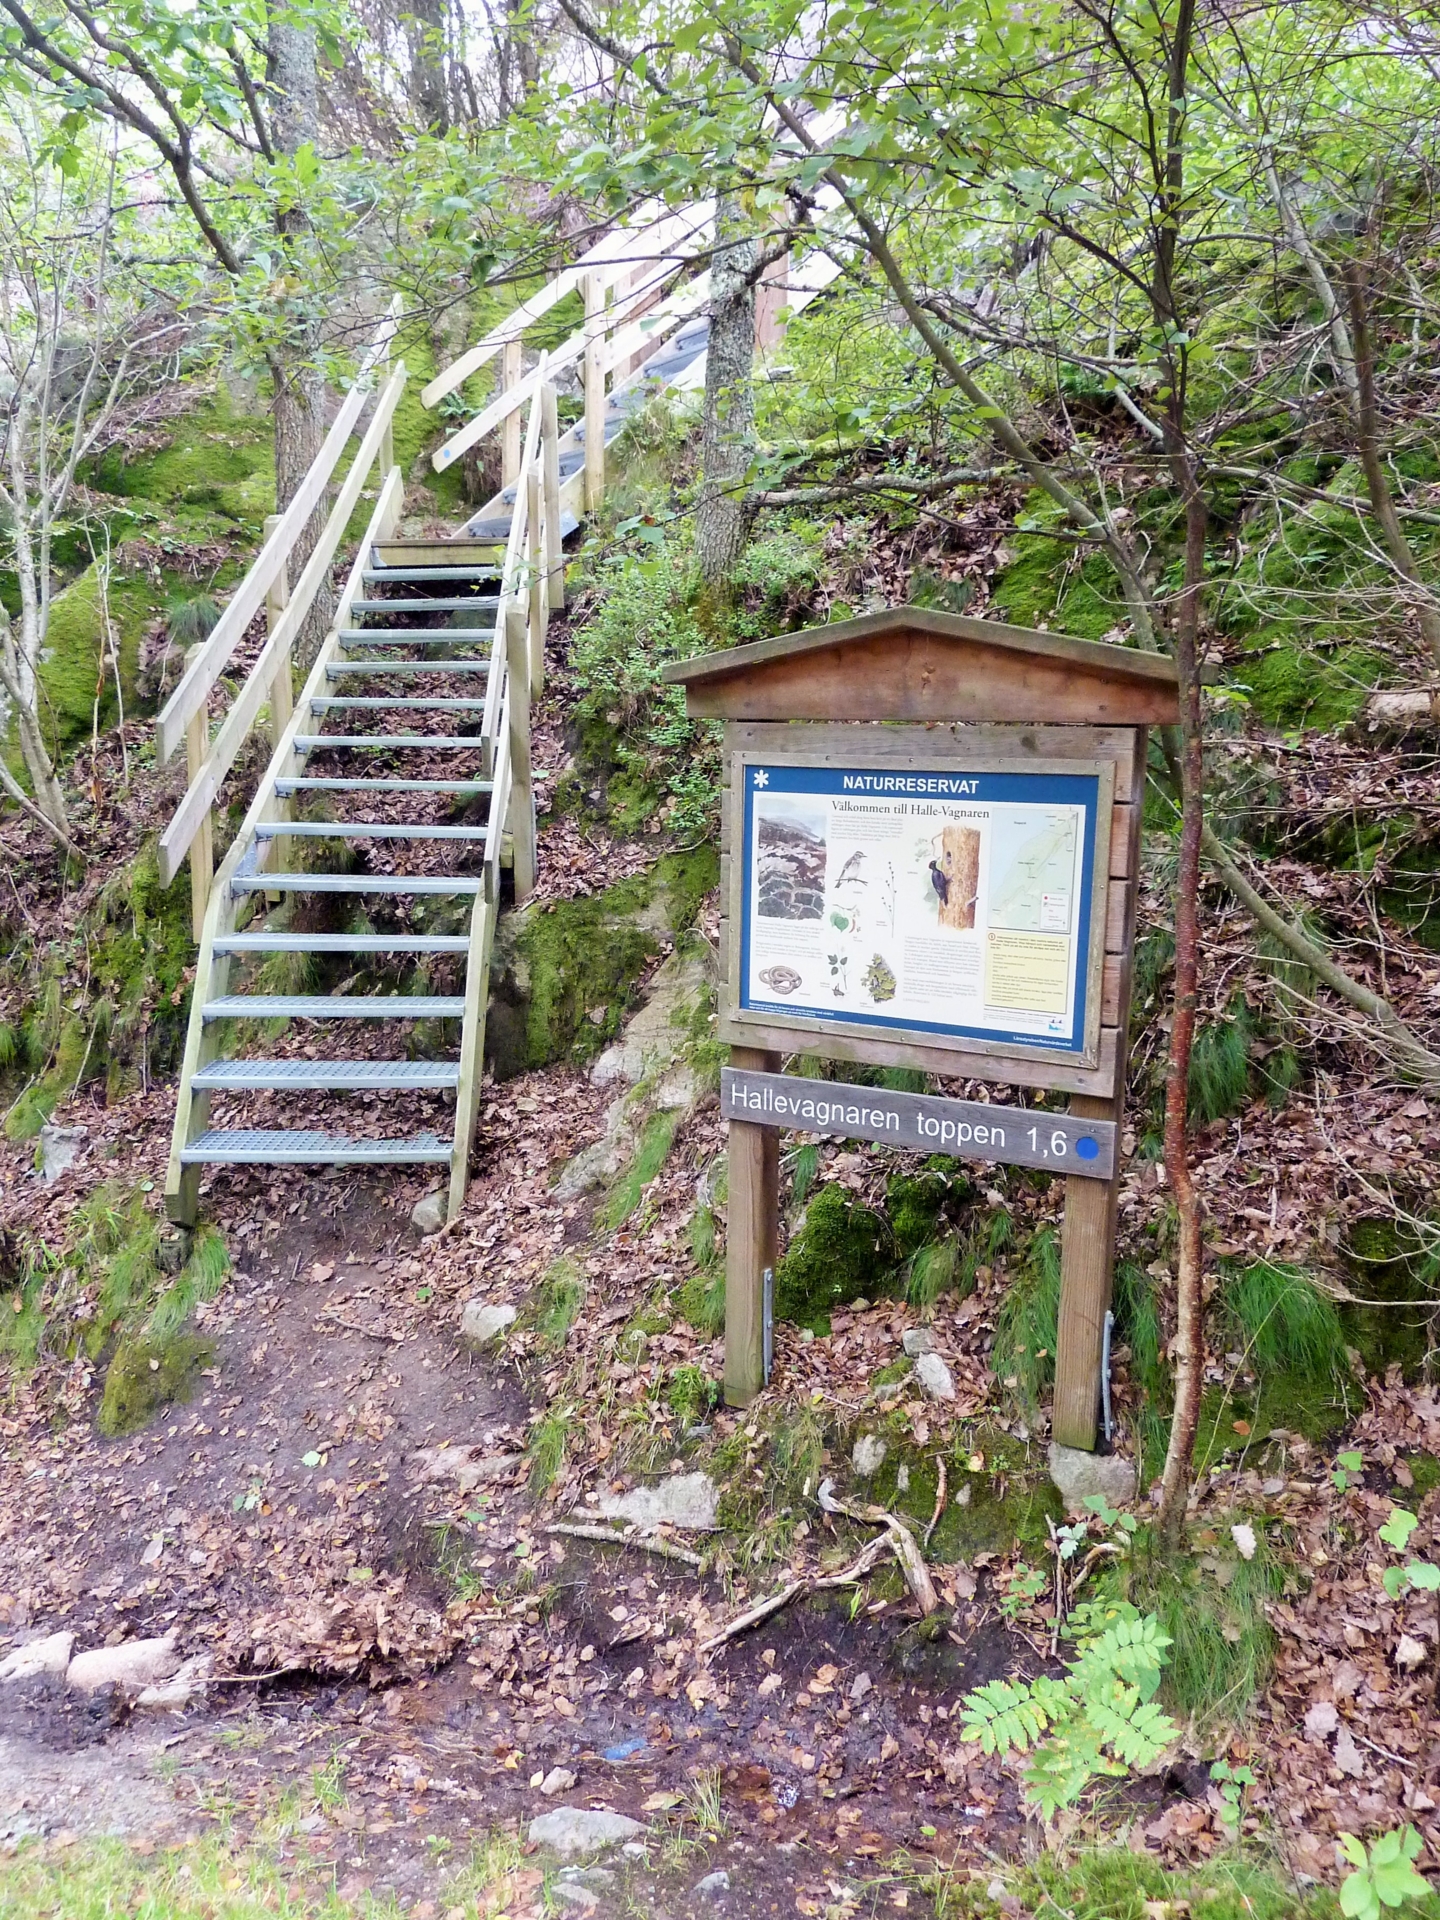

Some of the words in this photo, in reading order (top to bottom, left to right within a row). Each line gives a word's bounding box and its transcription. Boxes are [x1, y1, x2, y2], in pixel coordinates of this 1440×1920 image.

[843, 776, 979, 794] NATURRESERVAT
[832, 800, 890, 814] Välkommen
[894, 803, 908, 815] till
[911, 804, 990, 820] Halle-Vagnaren
[731, 1083, 900, 1131] Hallevagnaren
[916, 1112, 1006, 1147] toppen
[1026, 1127, 1067, 1158] 1,6
